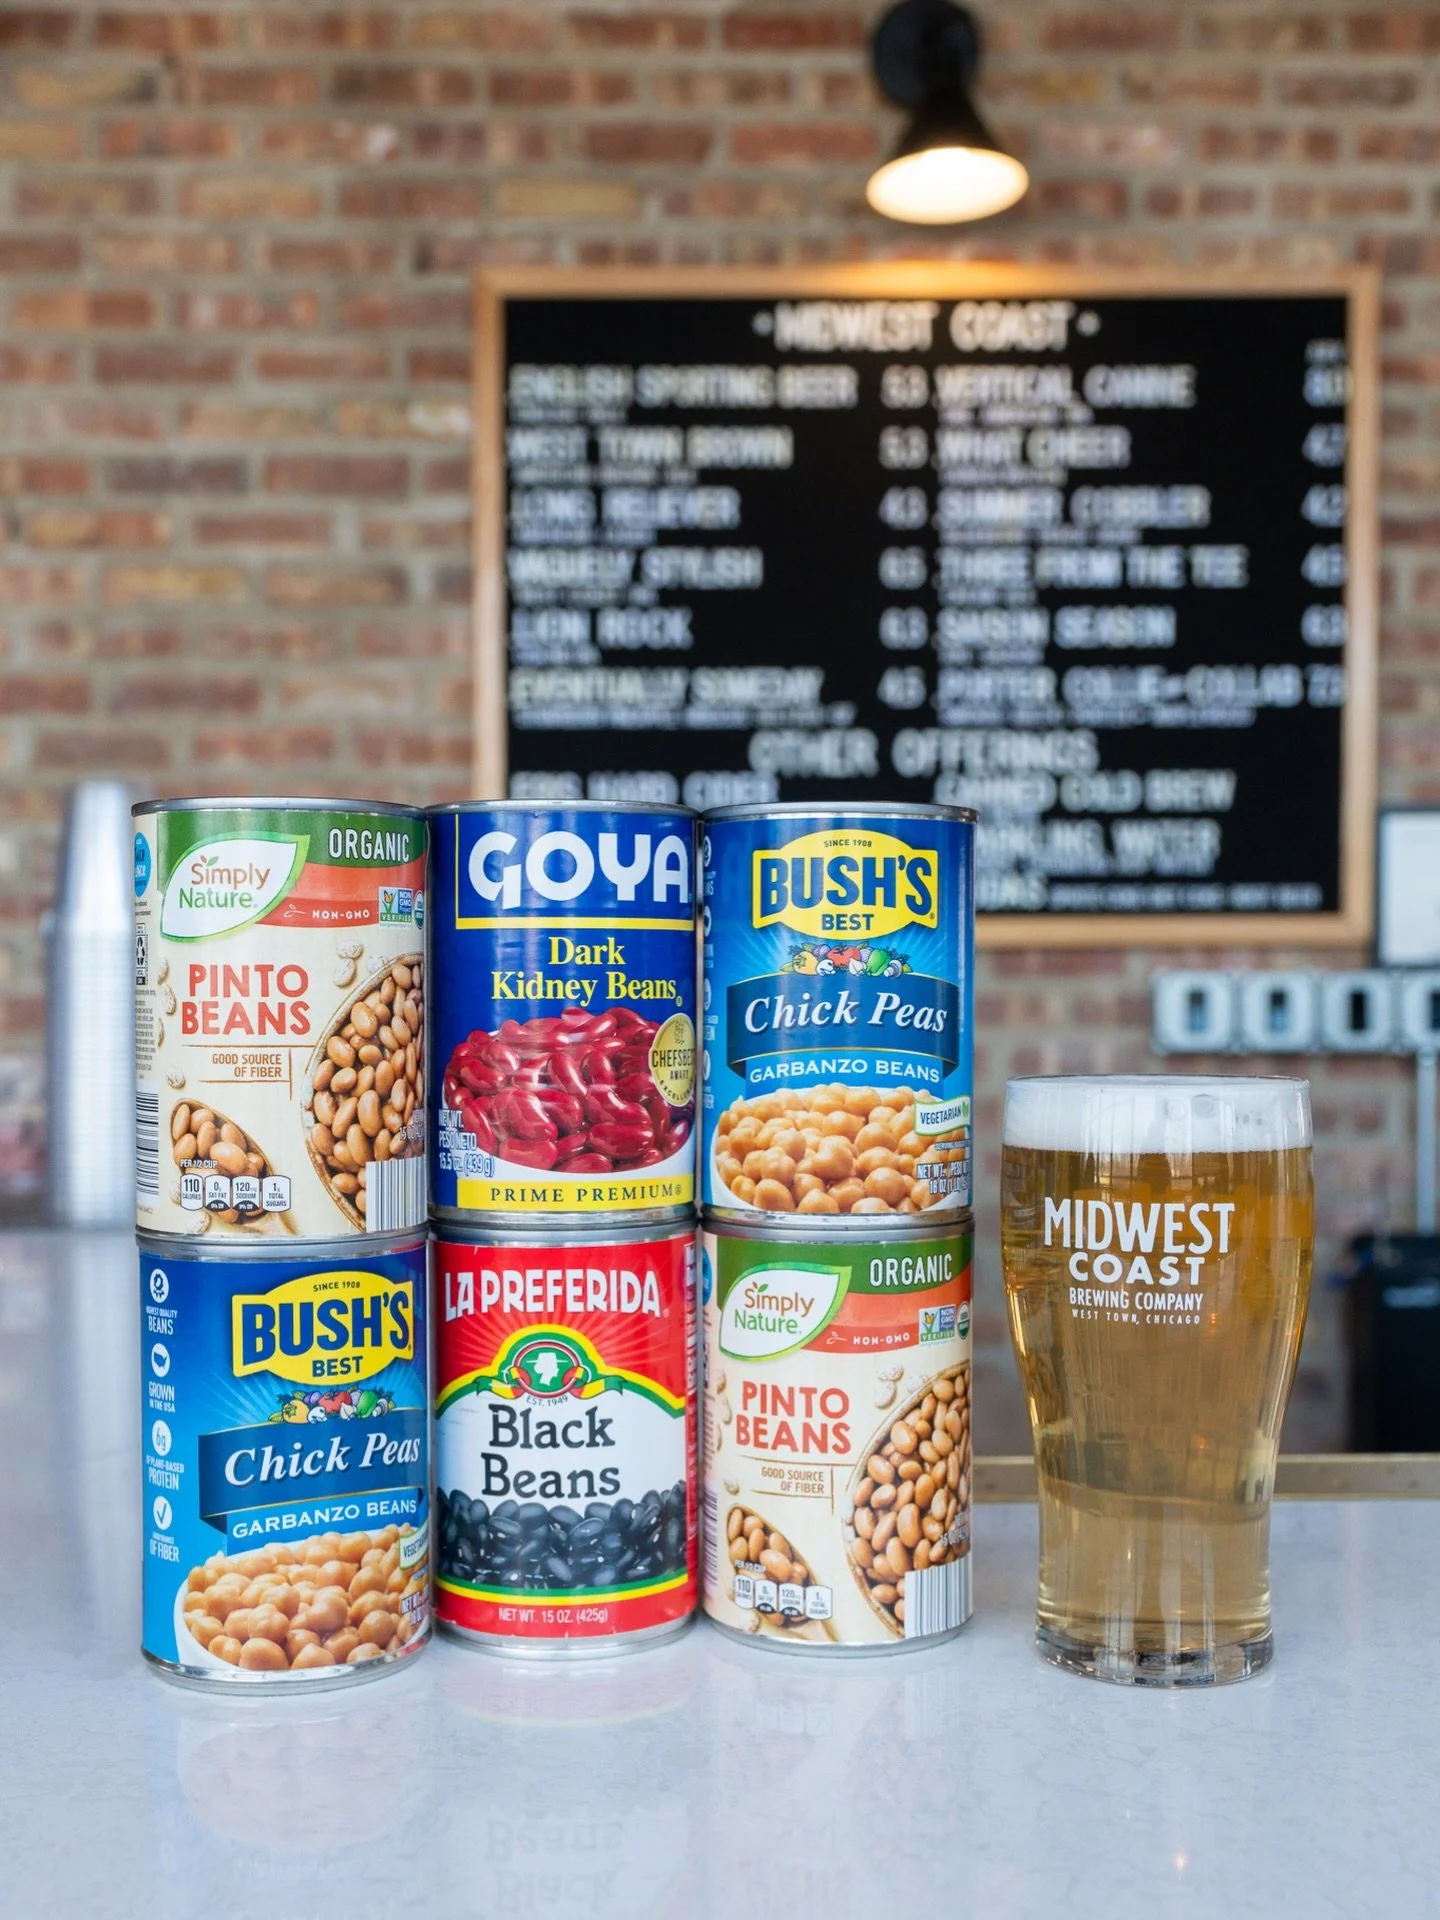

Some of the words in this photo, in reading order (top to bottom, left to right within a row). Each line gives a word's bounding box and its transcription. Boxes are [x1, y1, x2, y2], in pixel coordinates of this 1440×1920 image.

[329, 828, 410, 863] ORGANIC
[824, 839, 850, 847] SINCE
[853, 839, 872, 848] 1908
[191, 863, 270, 890] Simply
[468, 831, 689, 910] GOYA
[760, 855, 932, 918] BUSH'S
[312, 909, 370, 919] NON-GMO
[821, 914, 875, 931] BEST
[548, 937, 626, 965] Dark
[189, 964, 309, 998] PINTO
[491, 971, 598, 1007] Kidney
[606, 971, 676, 1000] Beans
[181, 1001, 311, 1036] BEANS
[745, 990, 859, 1033] Chick
[868, 991, 947, 1032] Peas
[212, 1053, 239, 1065] GOOD
[242, 1053, 282, 1065] SOURCE
[234, 1067, 248, 1078] OF
[250, 1067, 282, 1078] FIBER
[750, 1059, 867, 1083] GARBANZO
[875, 1059, 940, 1083] BEANS
[920, 1106, 961, 1124] VEGETARIAN
[184, 1178, 200, 1192] 110
[491, 1188, 564, 1202] PRIME
[1044, 1197, 1235, 1254] MIDWEST
[870, 1254, 952, 1287] ORGANIC
[1069, 1252, 1205, 1286] COAST
[313, 1281, 339, 1292] SINCE
[342, 1281, 360, 1289] 1908
[445, 1272, 474, 1322] LA
[481, 1269, 660, 1317] PREFERIDA
[744, 1288, 814, 1317] Simply
[1069, 1288, 1129, 1309] BREWING
[1135, 1292, 1203, 1311] COMPANY
[149, 1315, 173, 1335] BEANS
[242, 1290, 411, 1366] BUSH'S
[1072, 1309, 1098, 1320] WEST
[1107, 1312, 1139, 1324] TOWN,
[1146, 1313, 1200, 1325] CHICAGO
[853, 1333, 910, 1344] NON-GMO
[312, 1356, 363, 1377] BEST
[149, 1381, 175, 1402] GROWN
[527, 1396, 545, 1407] EST.
[547, 1396, 568, 1407] 1949
[742, 1380, 849, 1419] PINTO
[164, 1403, 175, 1413] USA
[489, 1403, 615, 1449] Black
[736, 1414, 851, 1455] BEANS
[156, 1428, 166, 1451] 6g
[225, 1437, 350, 1485] Chick
[359, 1433, 420, 1468] Peas
[149, 1467, 179, 1490] PROTEIN
[481, 1453, 620, 1498] Beans
[762, 1466, 786, 1480] GOOD
[788, 1468, 824, 1482] SOURCE
[781, 1481, 794, 1492] OF
[795, 1482, 824, 1494] FIBER
[233, 1504, 359, 1538] GARBANZO
[367, 1500, 417, 1516] BEANS
[157, 1541, 179, 1563] FIBER
[737, 1579, 750, 1593] 110
[499, 1608, 519, 1622] NET
[520, 1609, 538, 1623] WT.
[542, 1610, 554, 1623] 15
[557, 1610, 573, 1623] OZ.
[576, 1608, 608, 1624] (425g)
